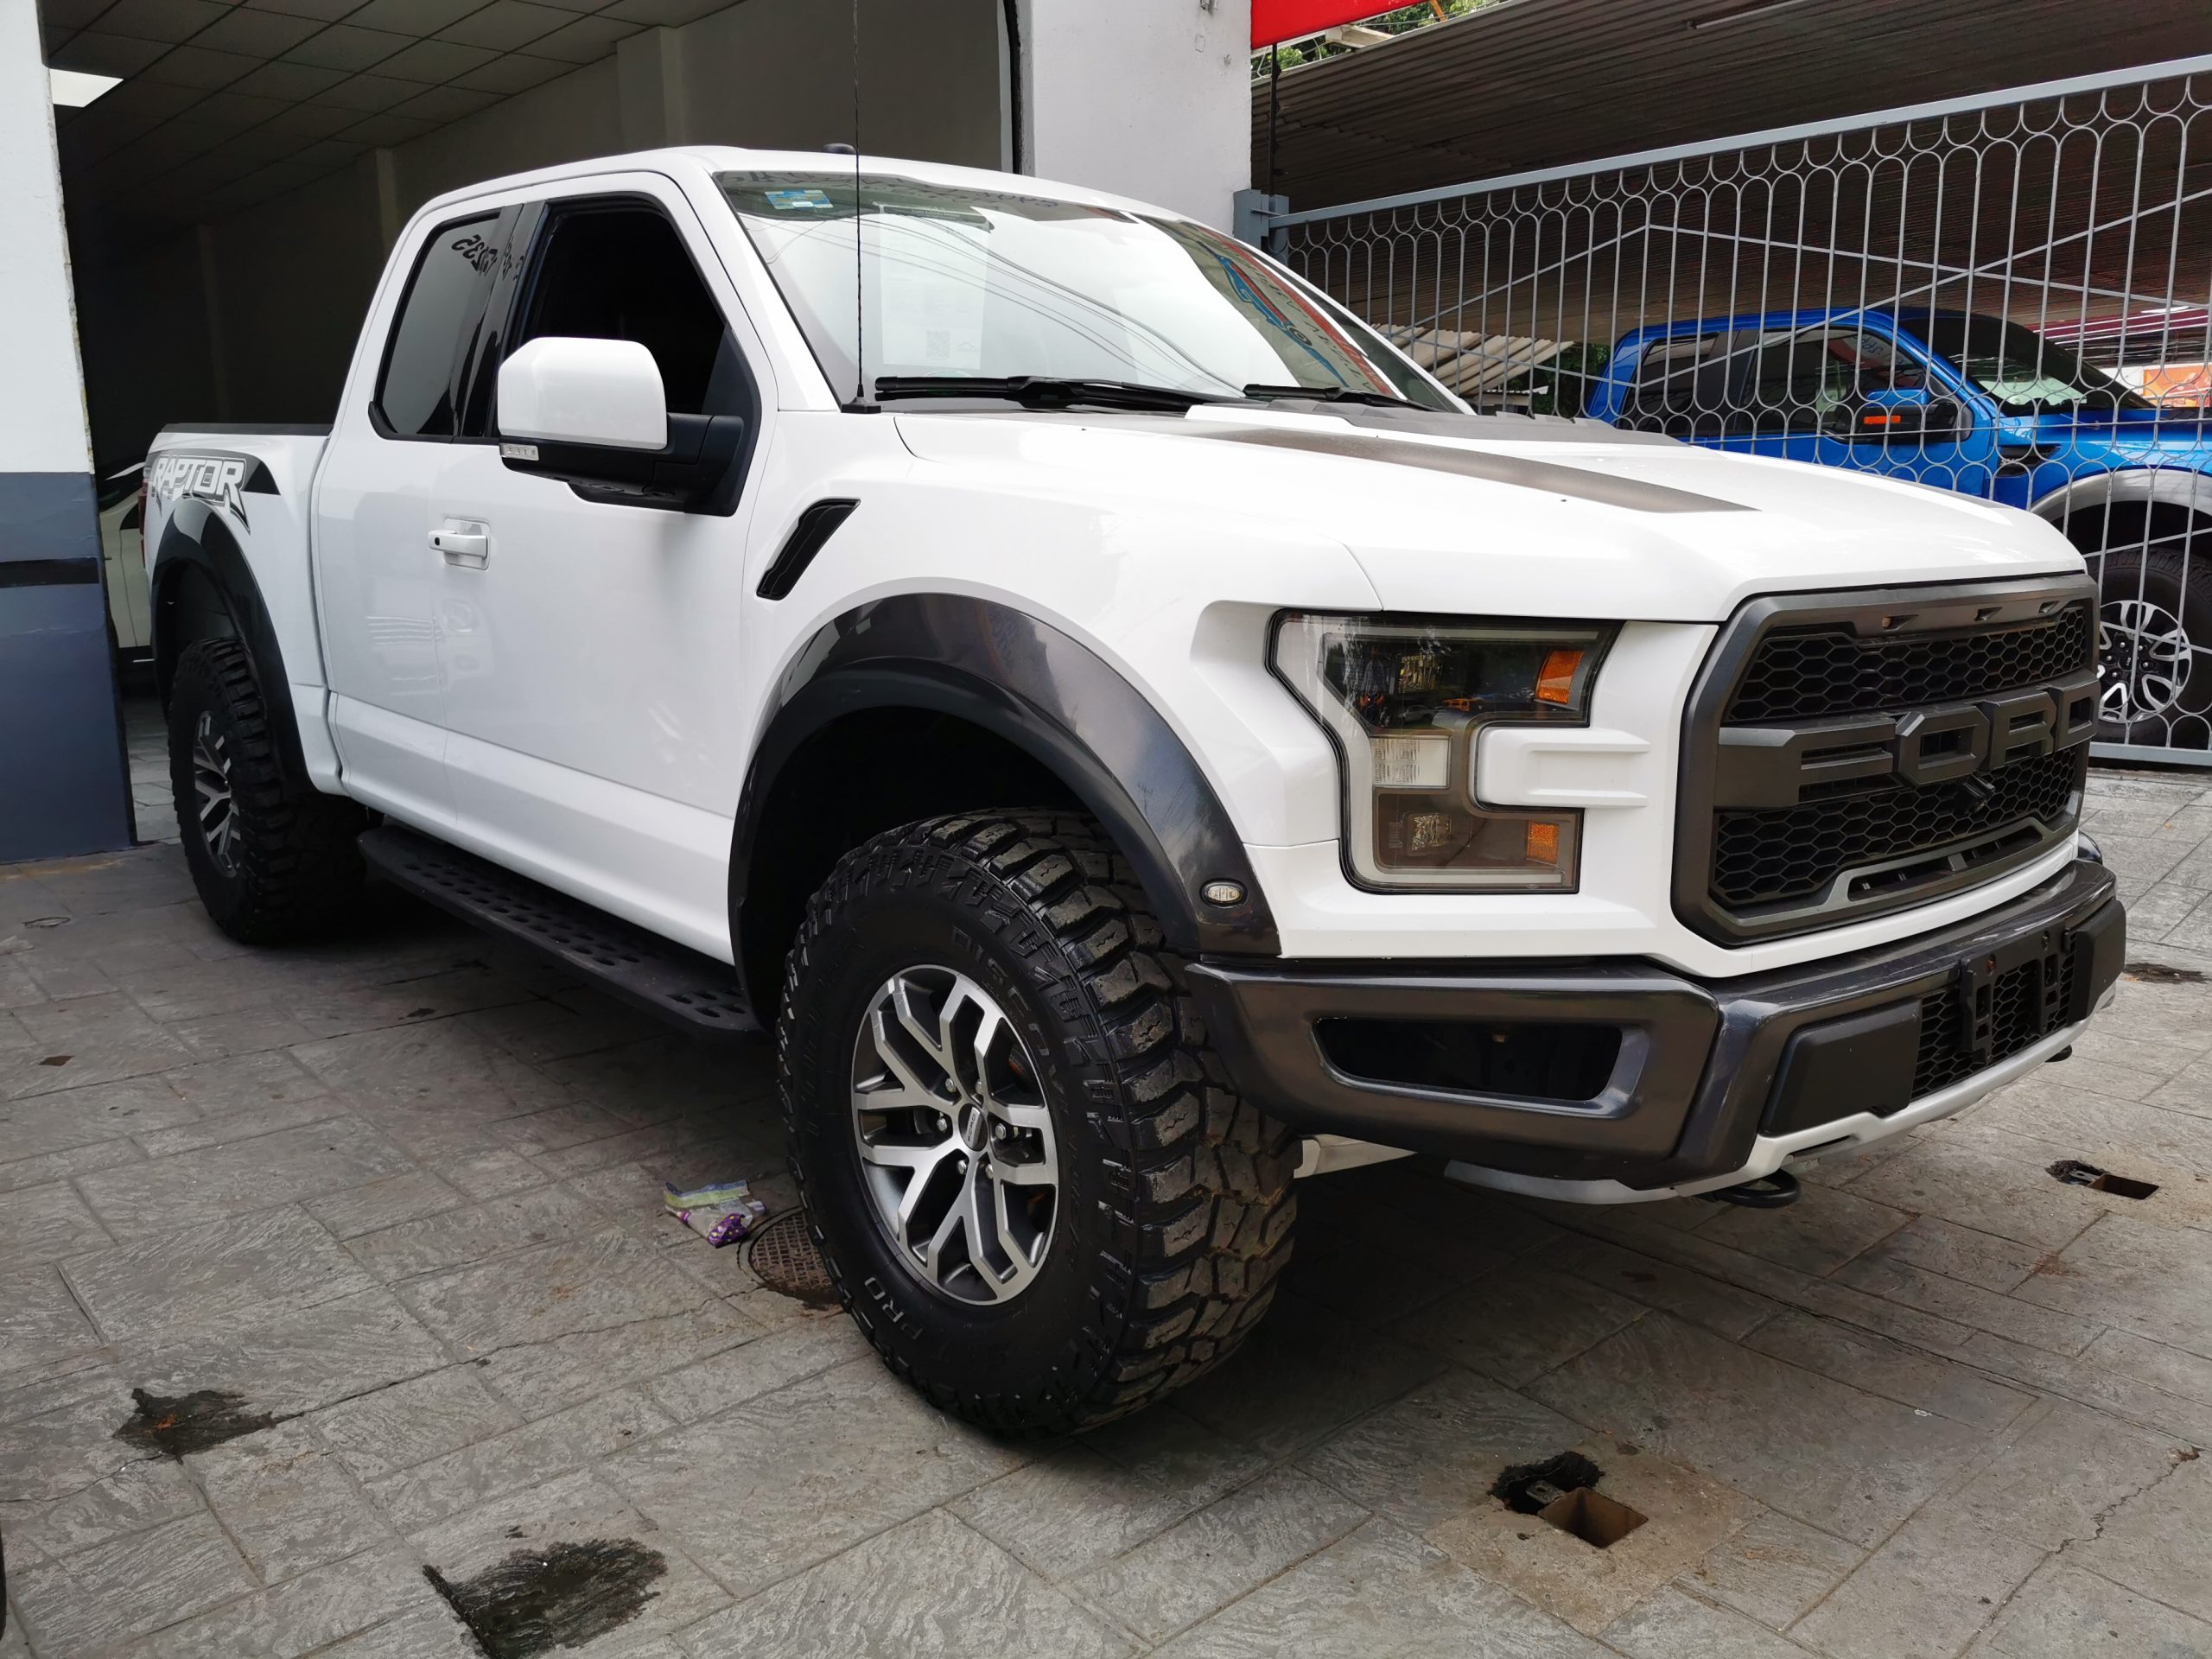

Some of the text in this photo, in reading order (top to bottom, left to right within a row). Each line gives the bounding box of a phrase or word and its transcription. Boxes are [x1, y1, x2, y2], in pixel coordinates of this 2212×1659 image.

[152, 455, 249, 524] RAPTOR
[1713, 671, 2101, 808] FORD
[967, 1112, 977, 1143] FORD
[865, 1277, 925, 1340] PRO
